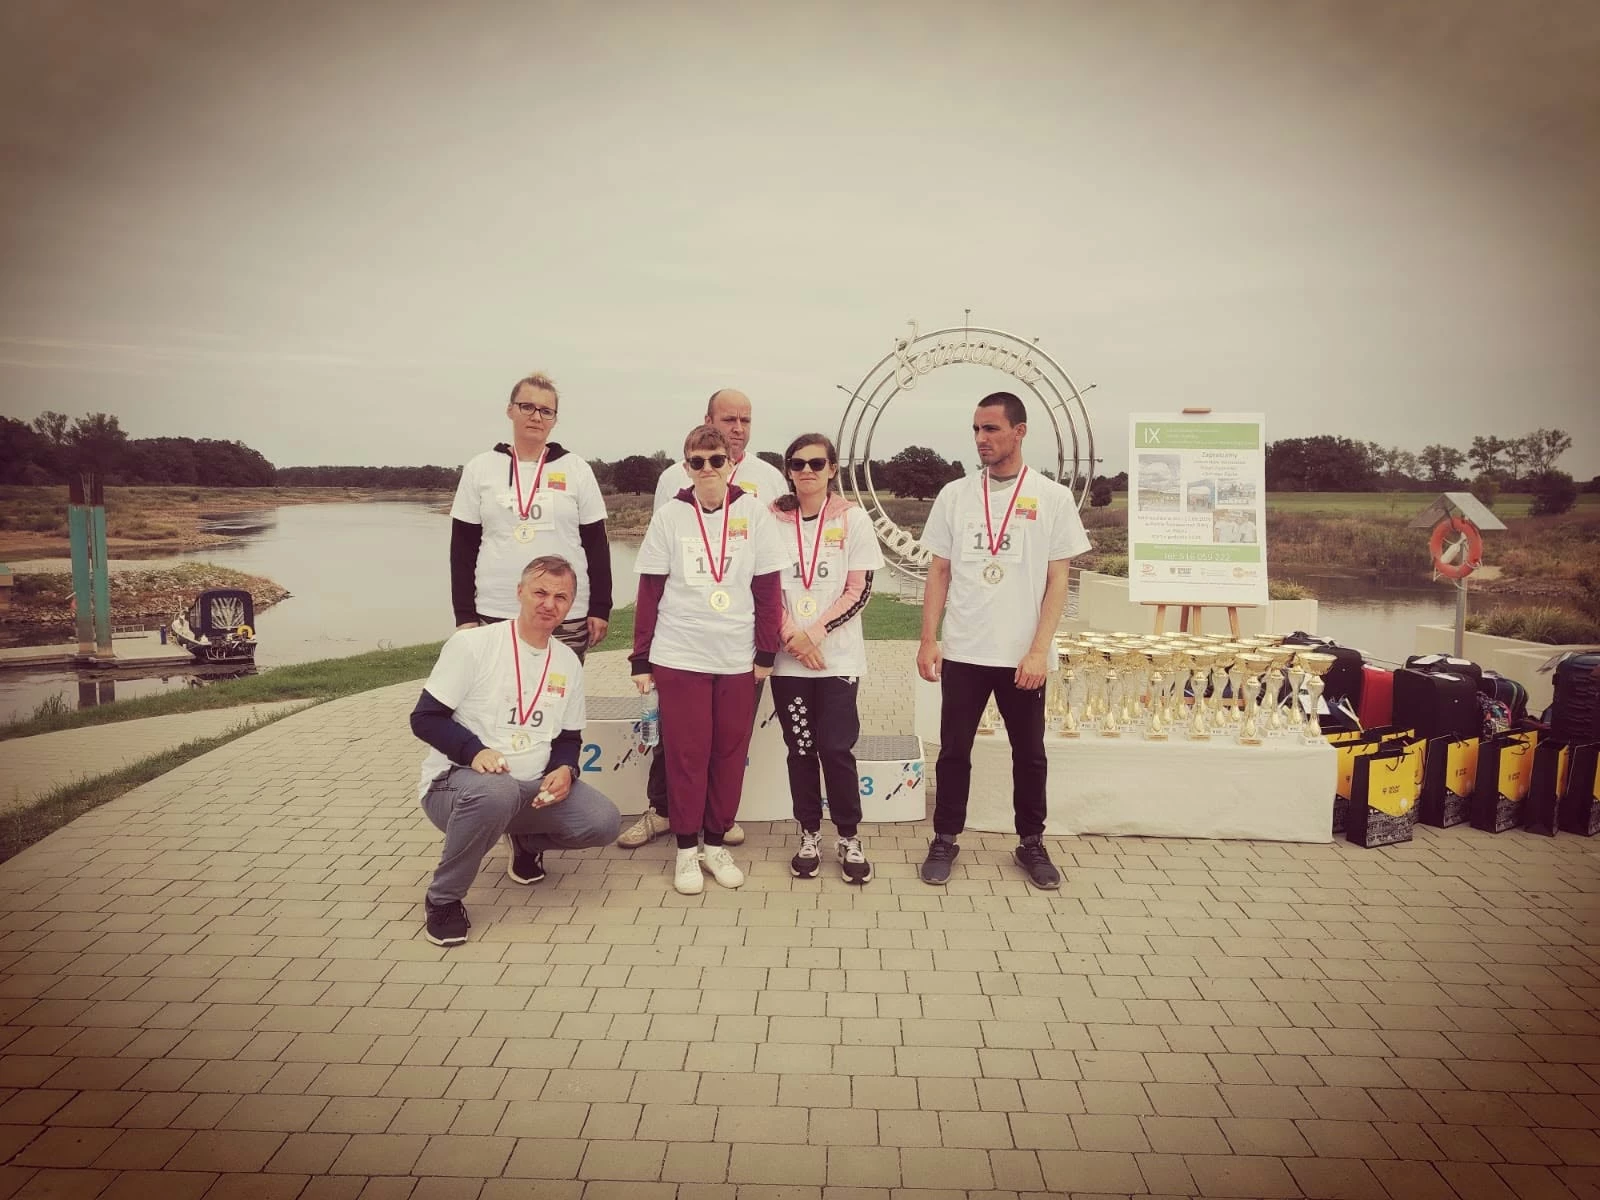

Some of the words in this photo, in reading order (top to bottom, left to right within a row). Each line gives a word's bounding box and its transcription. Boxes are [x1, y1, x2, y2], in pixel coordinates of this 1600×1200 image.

[1144, 427, 1161, 444] IX
[507, 707, 544, 728] 19
[582, 744, 602, 772] 2
[859, 776, 875, 796] 3
